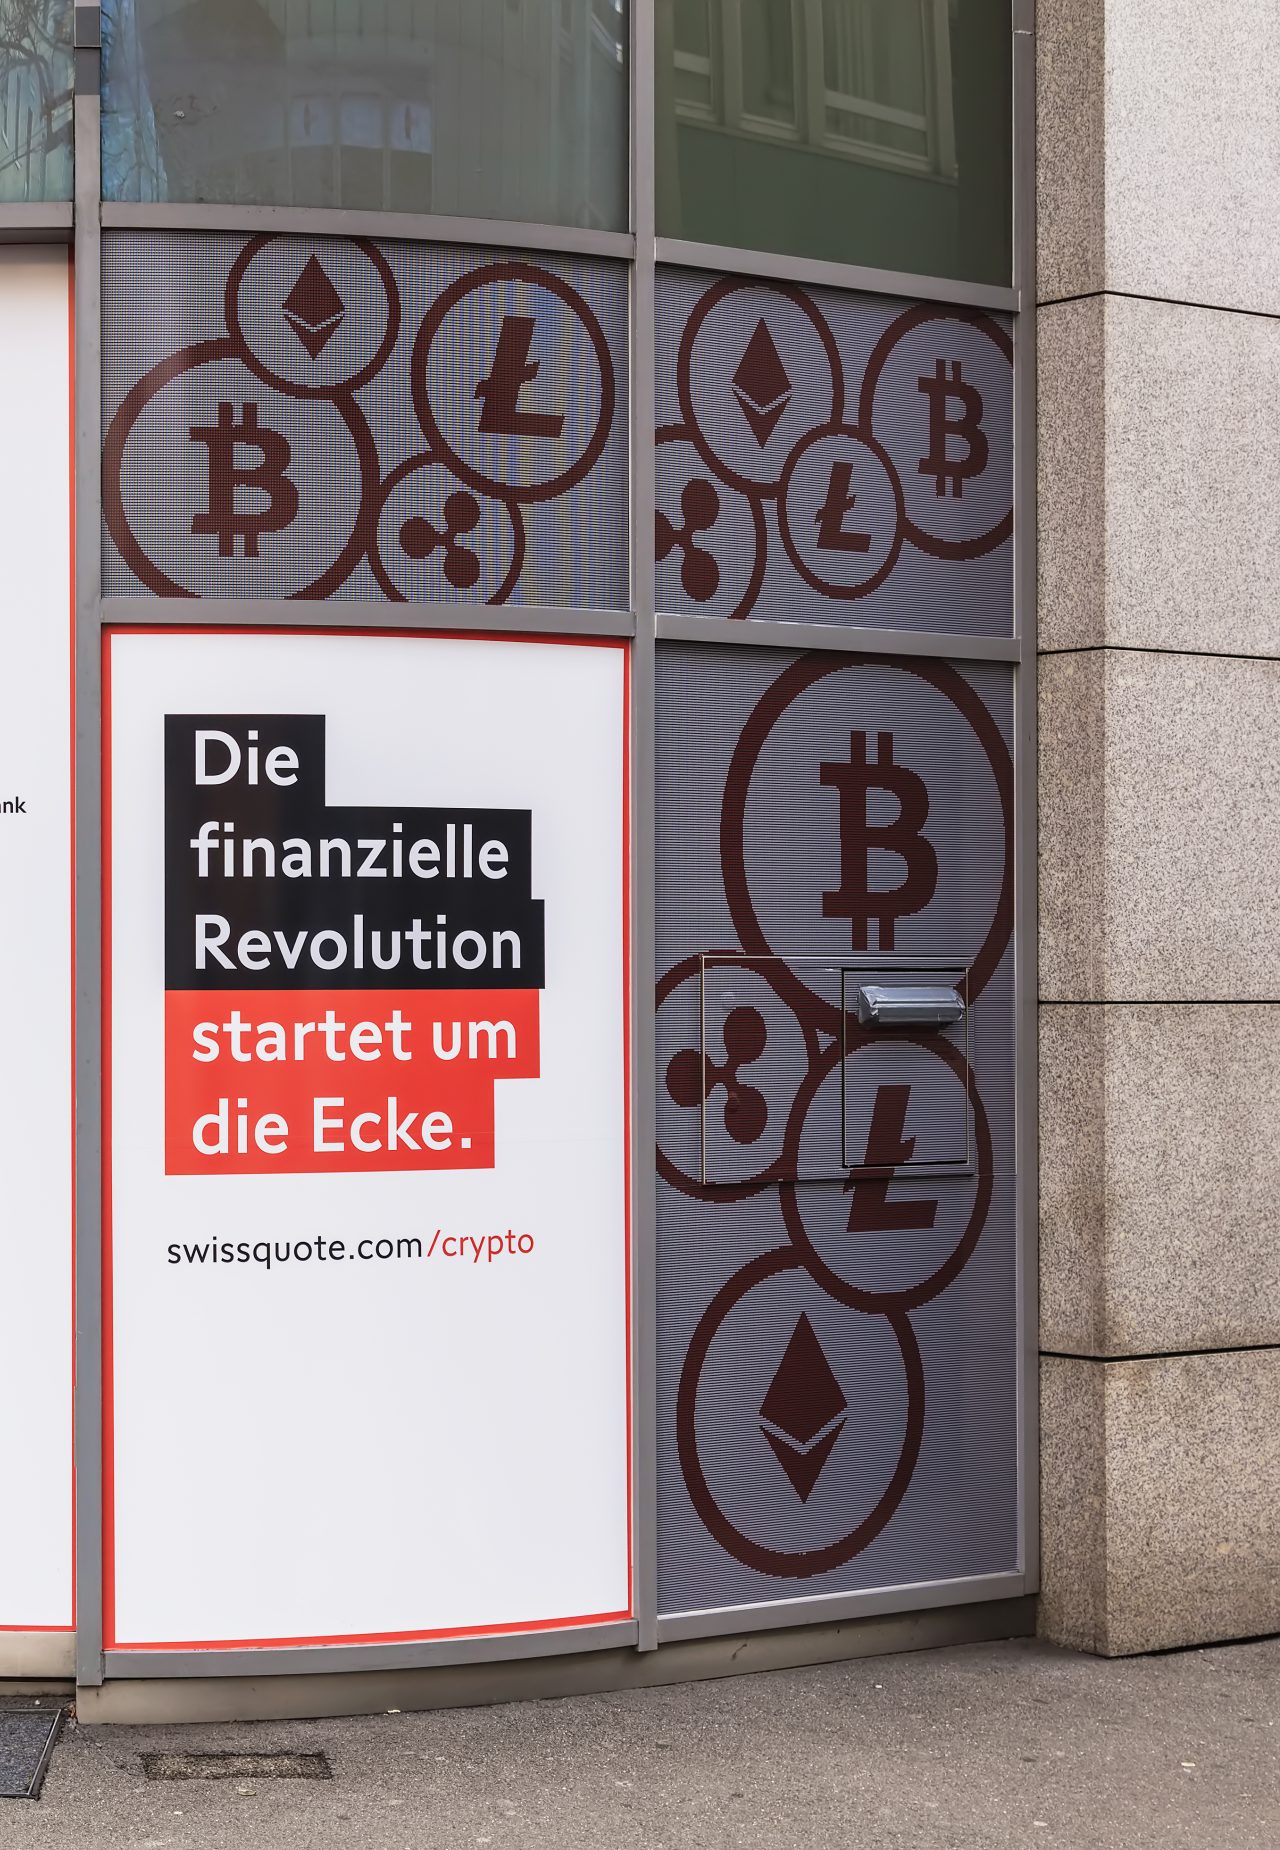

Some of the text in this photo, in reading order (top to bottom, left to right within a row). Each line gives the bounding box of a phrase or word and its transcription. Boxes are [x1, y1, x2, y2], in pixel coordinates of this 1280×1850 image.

[194, 729, 300, 786] Die
[190, 821, 509, 879] finanzielle
[194, 914, 522, 970] Revolution
[191, 1010, 518, 1062] startet um
[191, 1096, 472, 1155] die Ecke.
[167, 1229, 535, 1270] swissquote.com/crypto
